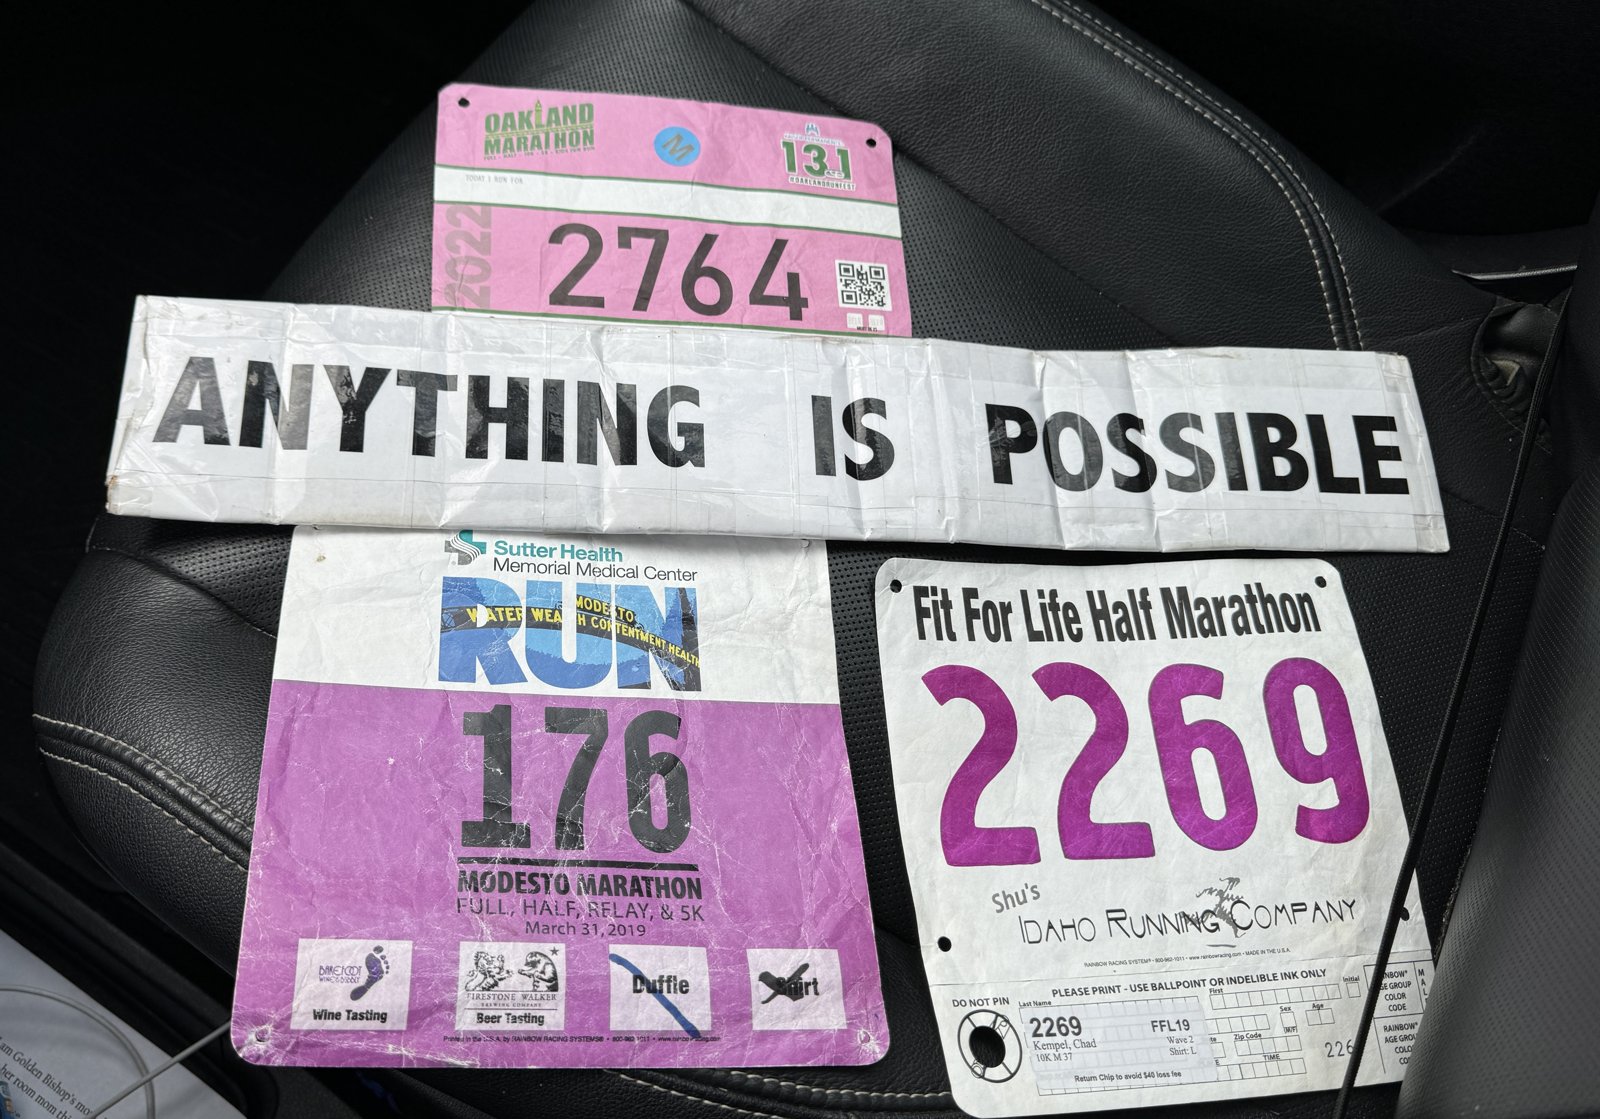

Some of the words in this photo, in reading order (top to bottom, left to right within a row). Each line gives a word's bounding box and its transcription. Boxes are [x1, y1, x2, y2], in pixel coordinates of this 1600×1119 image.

[485, 100, 595, 133] OAKLAND
[484, 129, 595, 156] MARATHON
[662, 134, 695, 162] M
[444, 204, 492, 309] 2022
[548, 223, 809, 321] 2764
[152, 356, 706, 469] ANYTHING
[811, 394, 895, 481] IS
[985, 402, 1410, 495] POSSIBLE
[494, 540, 557, 559] Sutter
[560, 543, 623, 563] Health
[493, 557, 571, 576] Memorial
[576, 561, 639, 579] Medical
[644, 565, 698, 582] Center
[576, 596, 634, 623] MODESTO
[913, 586, 957, 641] Fit
[962, 587, 1013, 643] For
[1020, 589, 1084, 643] Life
[1086, 588, 1157, 643] Half
[1158, 582, 1322, 640] Marathon
[438, 576, 702, 692] RUN
[531, 608, 586, 626] WEAH
[668, 642, 701, 669] HEALTH
[921, 657, 1370, 867] 2269
[461, 704, 692, 854] 176
[457, 870, 571, 895] MODESTO
[576, 874, 703, 900] MARATHON
[991, 882, 1041, 913] Shu's
[456, 897, 516, 917] FULL,
[523, 899, 581, 920] HALF,
[588, 902, 654, 922] RELAY,
[660, 905, 675, 921] &
[680, 905, 705, 922] 5K
[525, 921, 577, 936] March
[1018, 914, 1096, 944] IDAHO
[1105, 908, 1221, 939] RUNNING
[1229, 898, 1357, 931] COMPANY
[632, 974, 690, 995] Duffle
[1052, 987, 1090, 998] PLEASE
[1092, 984, 1122, 995] PRINT
[1129, 983, 1149, 993] USE
[1151, 978, 1208, 992] BALLPOINT
[1209, 977, 1225, 987] OR
[1226, 972, 1279, 985] INDELIBLE
[1280, 970, 1298, 981] INK
[1300, 968, 1327, 979] ONLY
[1343, 975, 1360, 983] Initial
[1389, 981, 1412, 990] GROUP
[467, 992, 516, 1001] FIRESTONE
[521, 992, 557, 1001] WALKER
[952, 999, 968, 1008] DO
[969, 998, 991, 1007] NOT
[993, 997, 1010, 1006] PIN
[1384, 993, 1407, 1001] COLOR
[1388, 1003, 1407, 1012] CODE
[313, 1008, 342, 1021] Wine
[345, 1009, 388, 1024] Tasting
[476, 1012, 503, 1024] Beer
[505, 1012, 545, 1026] Tasting
[1029, 1016, 1083, 1038] 2269
[1150, 1018, 1191, 1033] FFL19
[473, 1034, 482, 1042] the
[502, 1034, 510, 1044] by
[1033, 1040, 1071, 1052] Kempel,
[1073, 1038, 1097, 1049] Chad
[1167, 1035, 1190, 1045] Wave
[1190, 1035, 1195, 1044] 2
[1234, 1033, 1245, 1041] Zip
[1245, 1032, 1262, 1040] Code
[1384, 1035, 1400, 1044] AGE
[1036, 1053, 1052, 1062] 10K
[1053, 1053, 1063, 1062] M
[1063, 1052, 1073, 1062] 37
[1169, 1046, 1190, 1056] Shirt:
[1191, 1046, 1197, 1055] L
[1263, 1053, 1280, 1061] TIME
[1394, 1045, 1413, 1054] COLO
[13, 1051, 43, 1079] Golden
[42, 1073, 77, 1105] Bishop's
[75, 1102, 94, 1116] mo
[1074, 1074, 1098, 1083] Return
[1099, 1073, 1115, 1082] Chip
[1116, 1073, 1123, 1081] to
[1124, 1071, 1142, 1080] avoid
[1143, 1071, 1156, 1079] $40
[1157, 1070, 1170, 1079] loss
[1171, 1070, 1182, 1078] fee
[1, 1063, 15, 1081] her
[13, 1077, 37, 1098] room
[35, 1094, 58, 1115] mom
